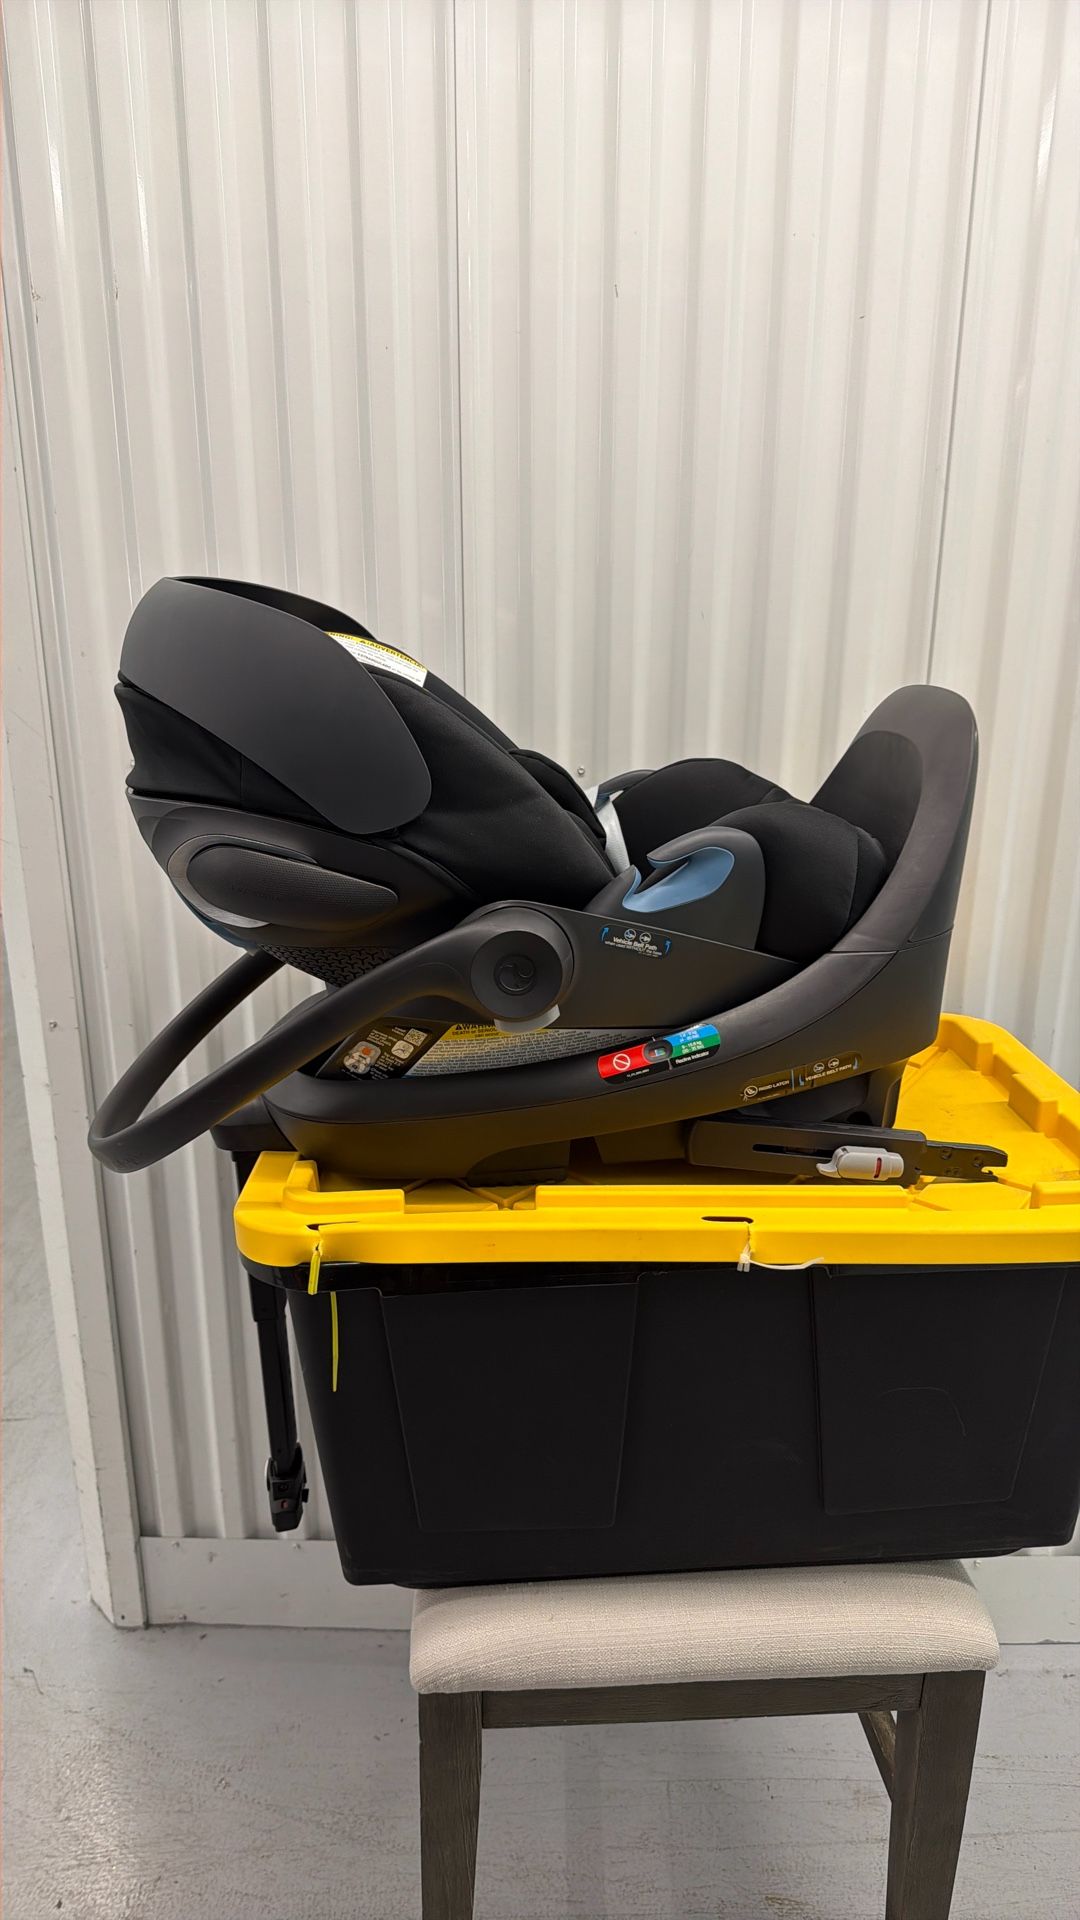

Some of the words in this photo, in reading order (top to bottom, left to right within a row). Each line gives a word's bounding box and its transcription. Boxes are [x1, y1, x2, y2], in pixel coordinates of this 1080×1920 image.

[613, 936, 633, 946] Vehicle
[645, 943, 658, 951] Path
[675, 1056, 691, 1064] Recline
[691, 1051, 710, 1059] Indicator
[805, 1071, 826, 1081] VEHICLE
[826, 1067, 839, 1075] BELT
[839, 1063, 852, 1071] PATH
